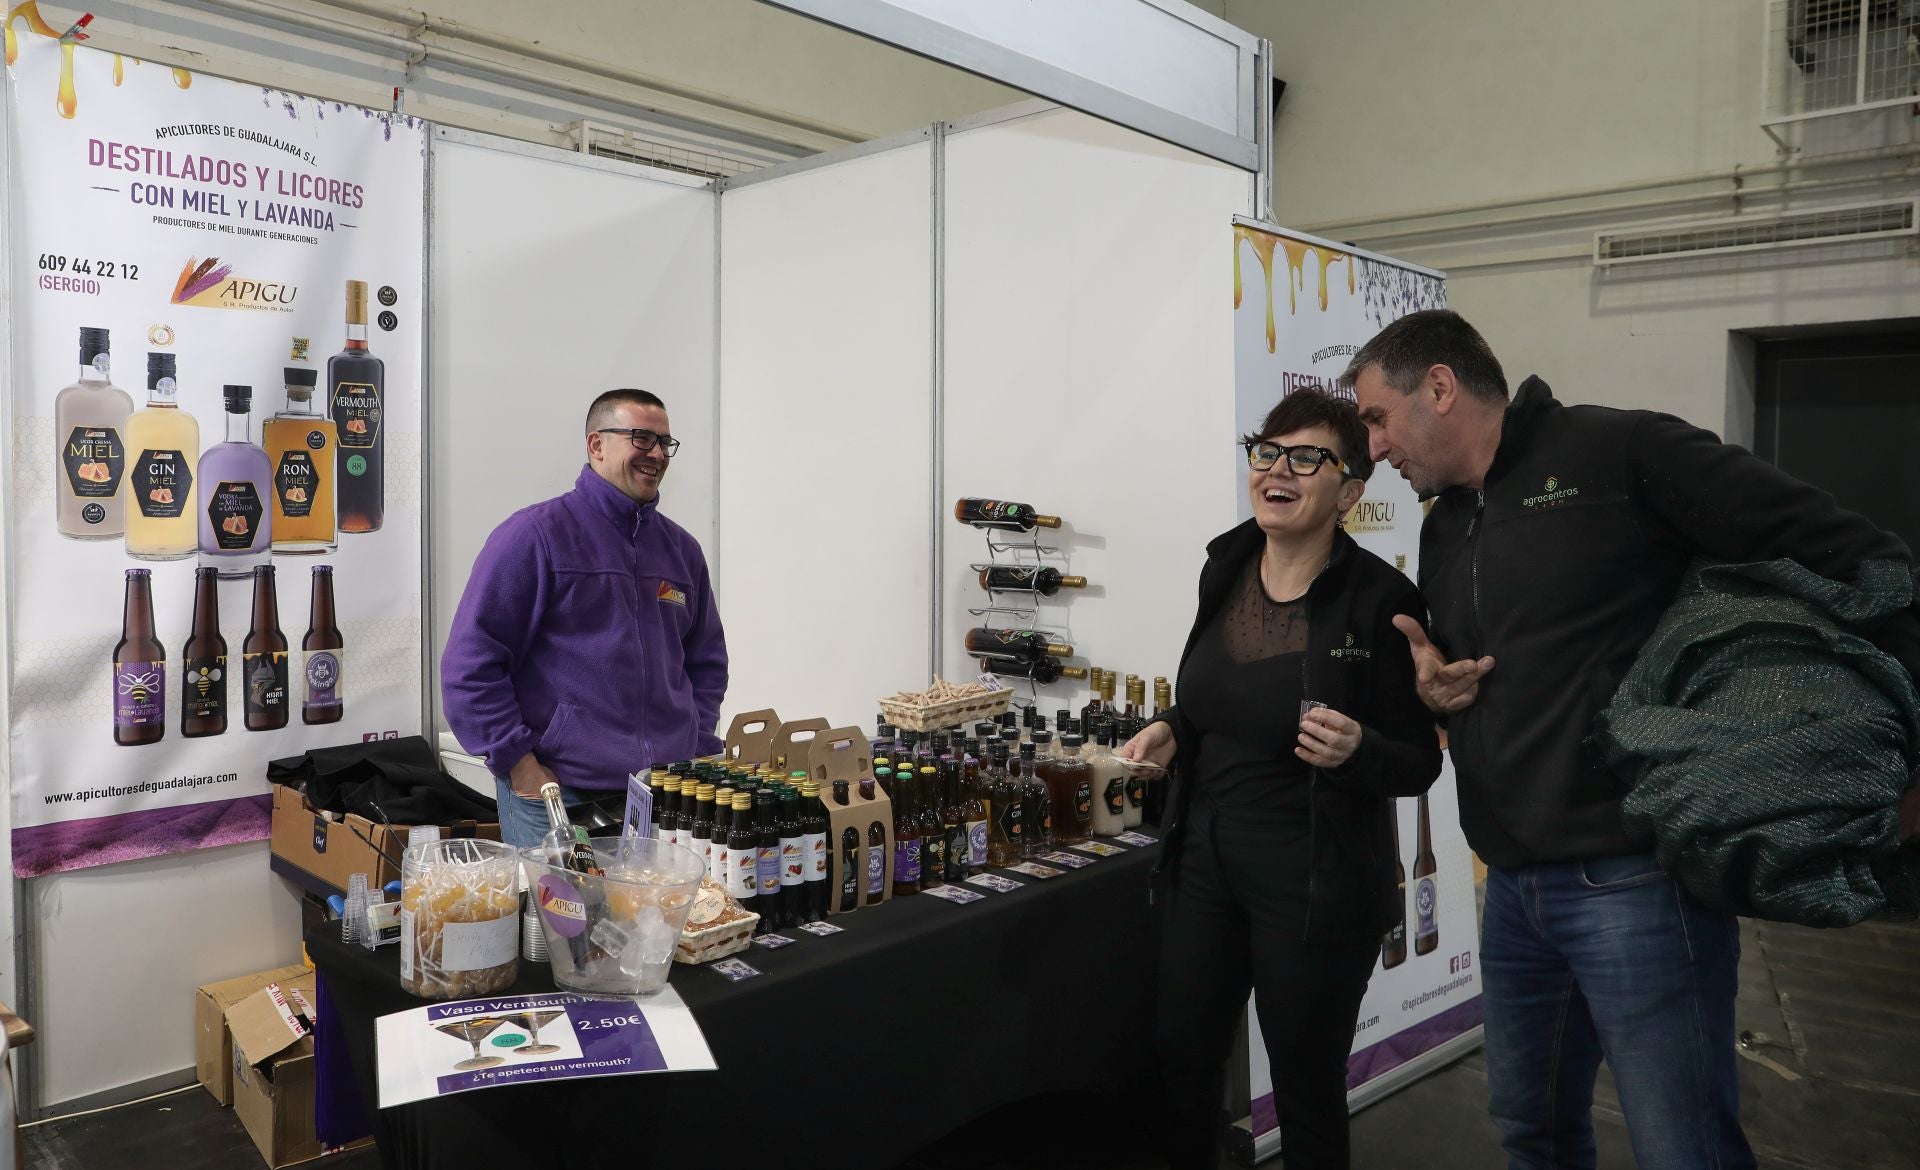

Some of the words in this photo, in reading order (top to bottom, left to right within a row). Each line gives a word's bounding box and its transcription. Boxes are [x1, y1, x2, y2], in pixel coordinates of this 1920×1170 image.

[155, 124, 220, 140] APICULTORES
[223, 126, 235, 138] DE
[238, 128, 301, 158] GUADALAJARA
[303, 151, 318, 167] S.L.
[89, 138, 247, 188] DESTILADOS
[256, 165, 269, 191] Y
[278, 169, 364, 209] LICORES
[131, 182, 174, 208] CON
[182, 188, 231, 216] MIEL
[238, 199, 248, 218] Y
[254, 200, 334, 232] LAVANDA
[152, 215, 206, 230] PRODUCTORES
[207, 222, 217, 231] DE
[218, 224, 235, 234] MIEL
[237, 226, 268, 239] DURANTE
[269, 231, 318, 245] GENERACIONES
[38, 253, 67, 272] 609
[71, 257, 92, 275] 44
[96, 260, 115, 278] 22
[120, 263, 139, 280] 12
[39, 274, 101, 297] (SERGIO)
[219, 280, 298, 304] APIGU
[336, 396, 378, 408] VERMOUTH
[70, 443, 120, 459] MIEL
[150, 463, 175, 475] GIN
[283, 464, 310, 475] RON
[351, 462, 362, 471] 88
[149, 476, 176, 486] MIEL
[285, 476, 309, 485] MIEL
[1522, 487, 1579, 507] agrocentros
[1353, 502, 1395, 523] APIGU
[44, 772, 238, 805] www.apicultoresdeguadalajara.com
[553, 899, 583, 914] APIGU
[440, 1005, 485, 1016] Vaso
[490, 996, 577, 1010] Vermouth
[578, 1015, 642, 1030] 2.50€
[473, 1072, 495, 1082] ¿Te
[498, 1066, 547, 1078] apetece
[550, 1063, 565, 1071] un
[568, 1057, 631, 1070] vermouth?
